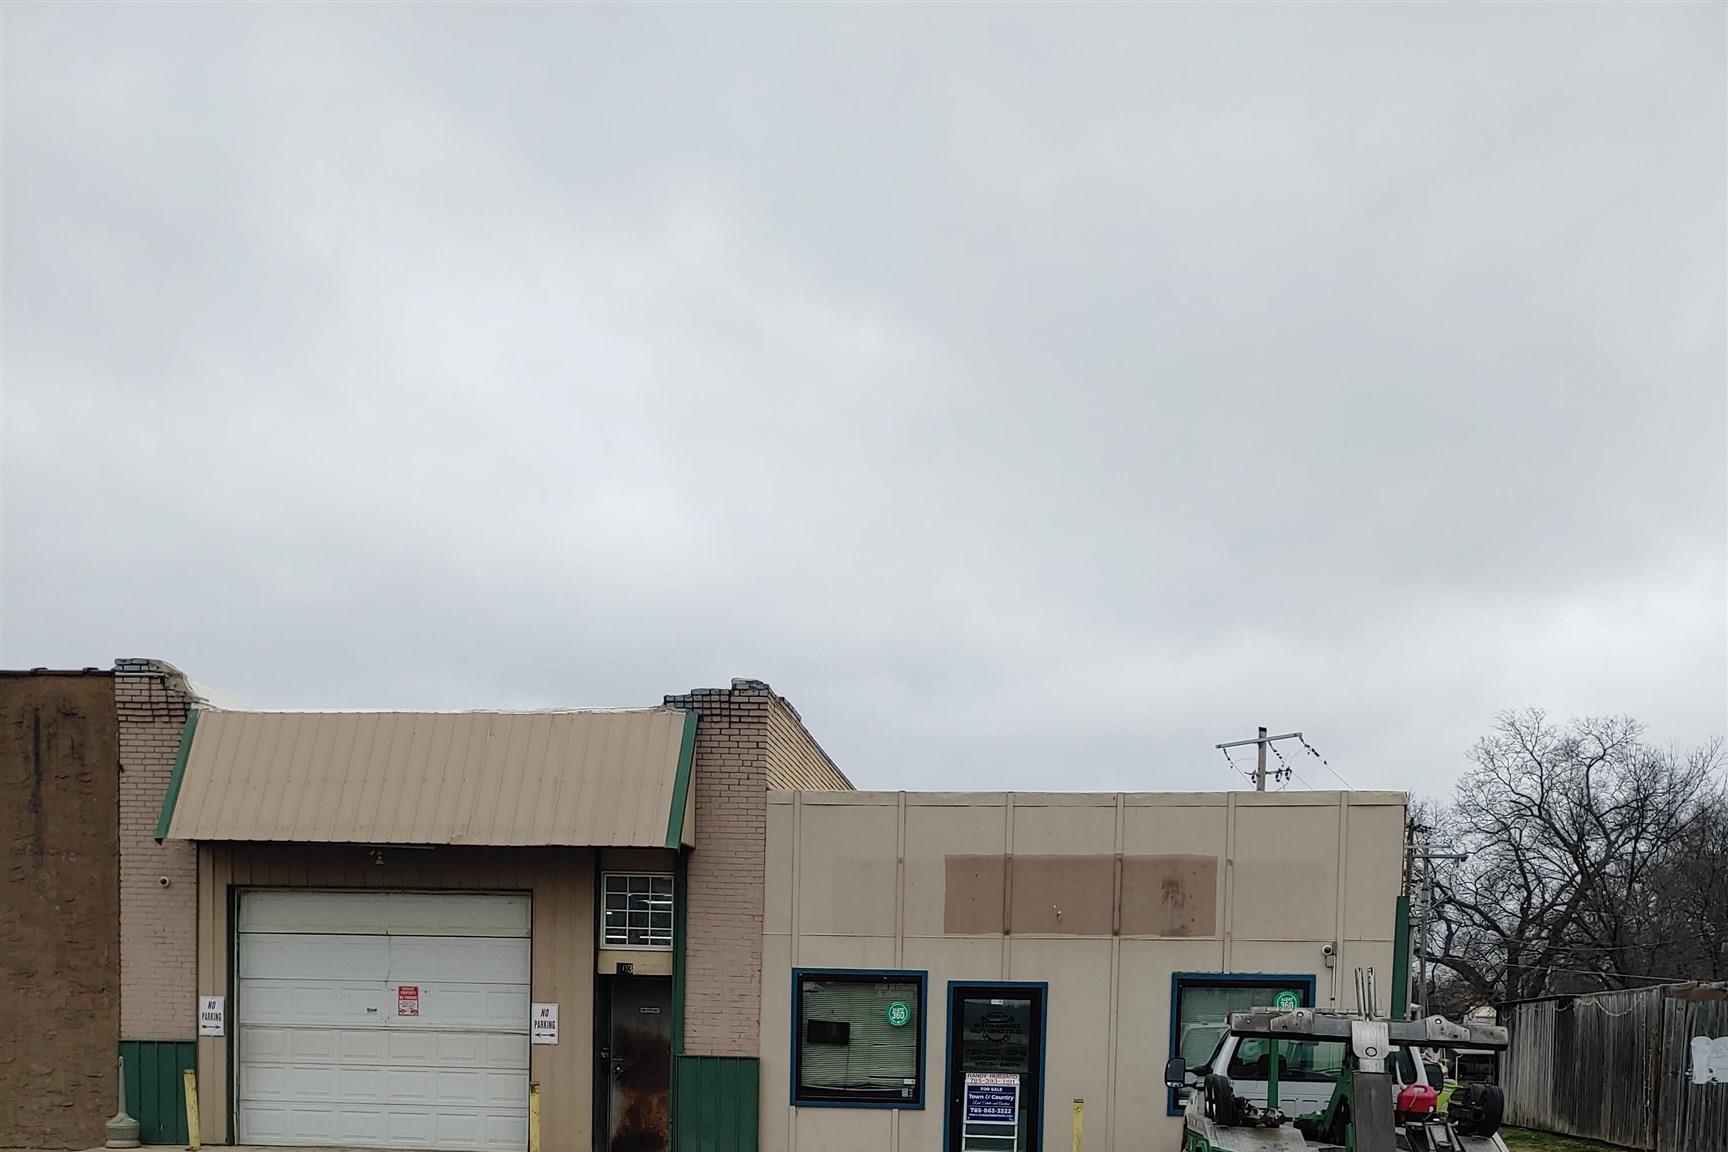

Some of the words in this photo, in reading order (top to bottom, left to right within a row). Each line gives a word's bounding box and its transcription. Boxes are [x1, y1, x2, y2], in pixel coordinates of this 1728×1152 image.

[207, 1000, 216, 1010] NO
[201, 1011, 222, 1022] PARKING
[540, 1008, 550, 1018] NO
[891, 1011, 905, 1020] 360
[534, 1019, 556, 1030] PARKING
